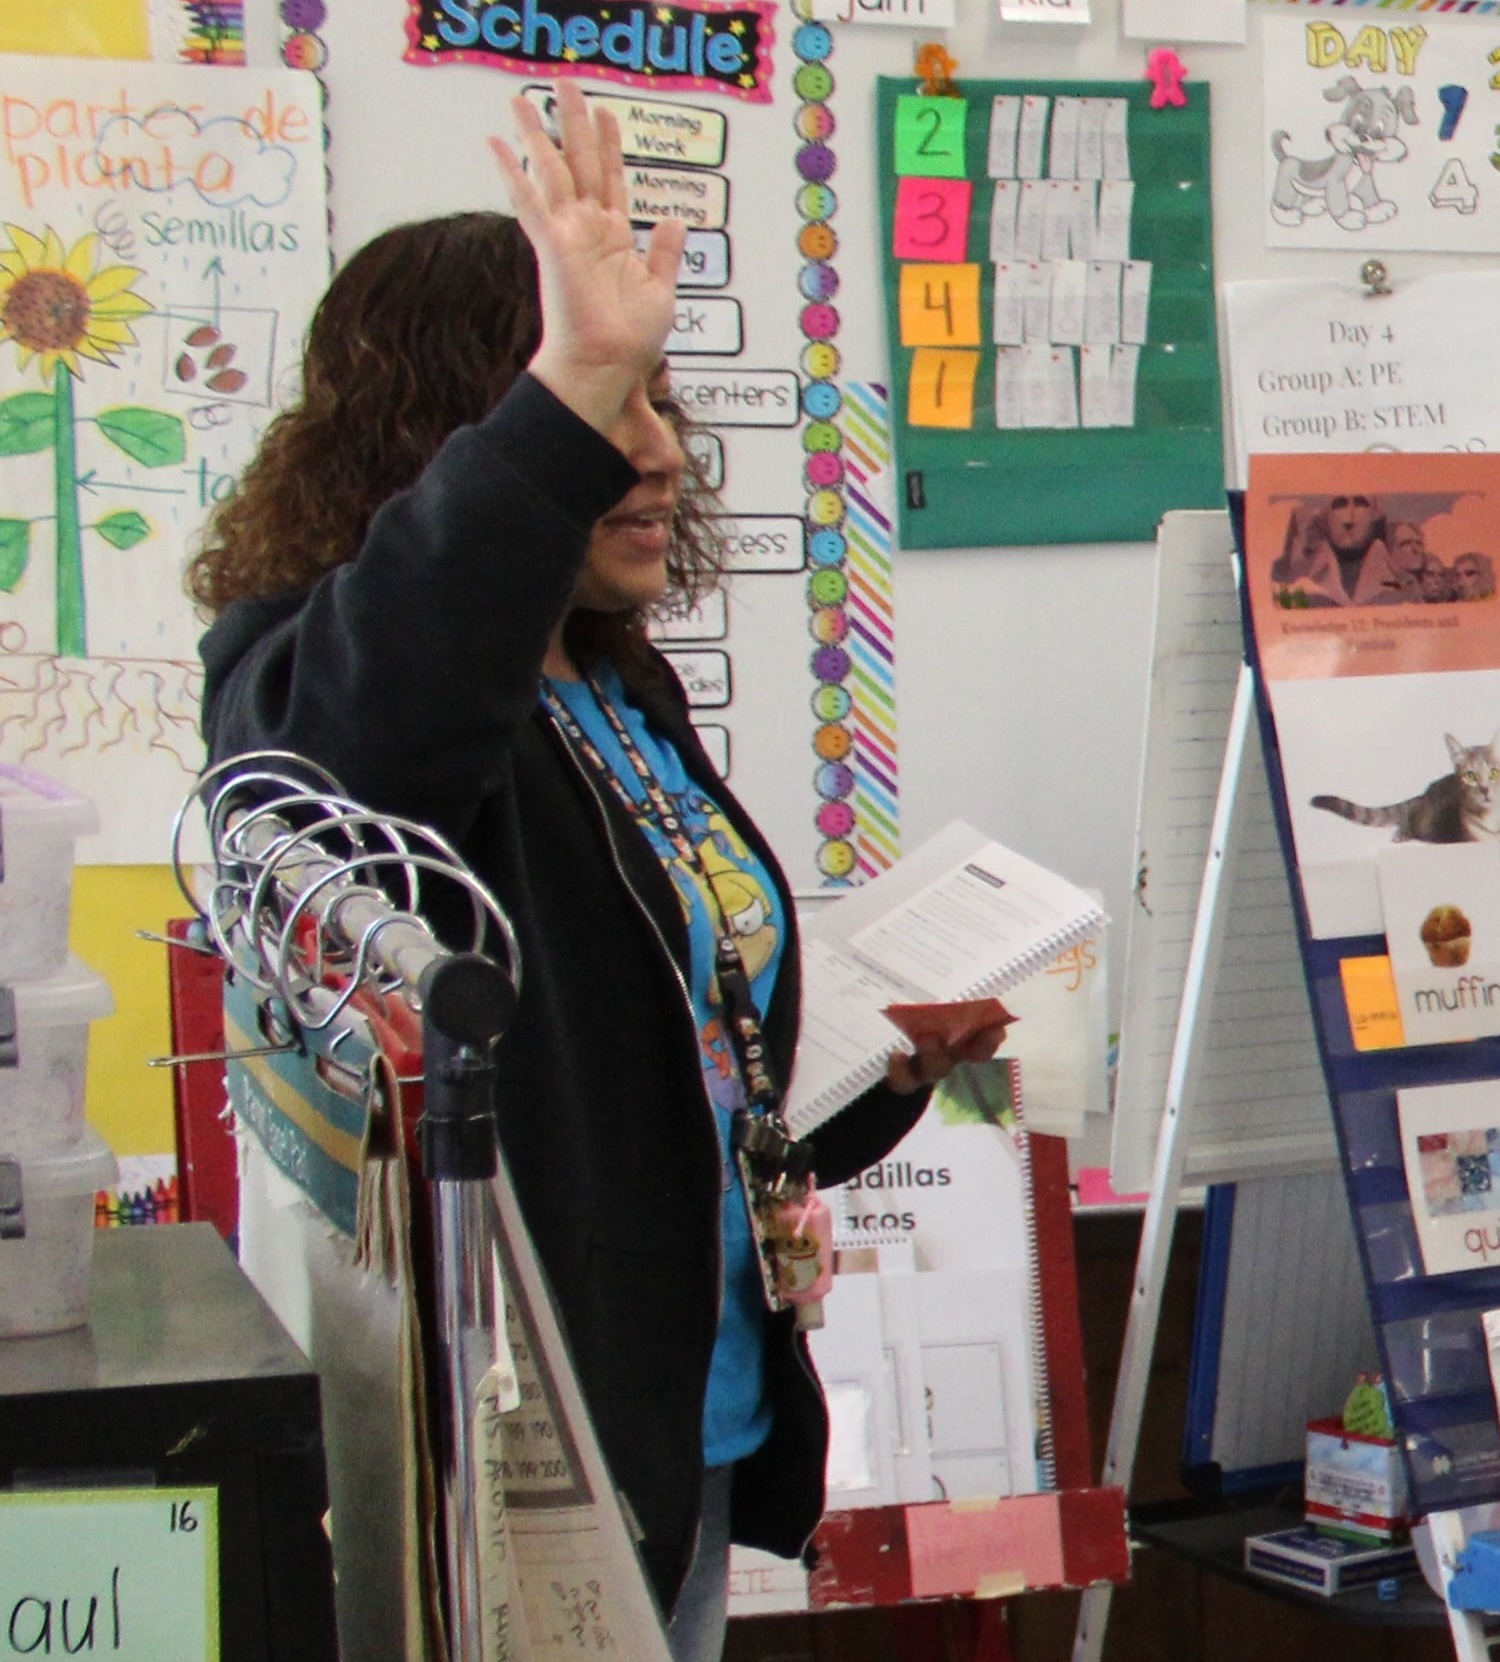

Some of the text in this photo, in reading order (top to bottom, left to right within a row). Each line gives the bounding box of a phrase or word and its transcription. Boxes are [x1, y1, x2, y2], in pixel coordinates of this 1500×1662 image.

[436, 0, 745, 76] Schedule
[1305, 21, 1428, 76] DAY
[634, 134, 687, 158] Work
[916, 107, 950, 156] 2
[1429, 158, 1478, 214] 4
[911, 191, 950, 247] 3
[924, 280, 952, 337] 4
[1328, 320, 1394, 345] Day 4
[1258, 361, 1403, 393] Group A: PE
[1263, 403, 1447, 437] Group B: STEM
[169, 1501, 200, 1535] 16
